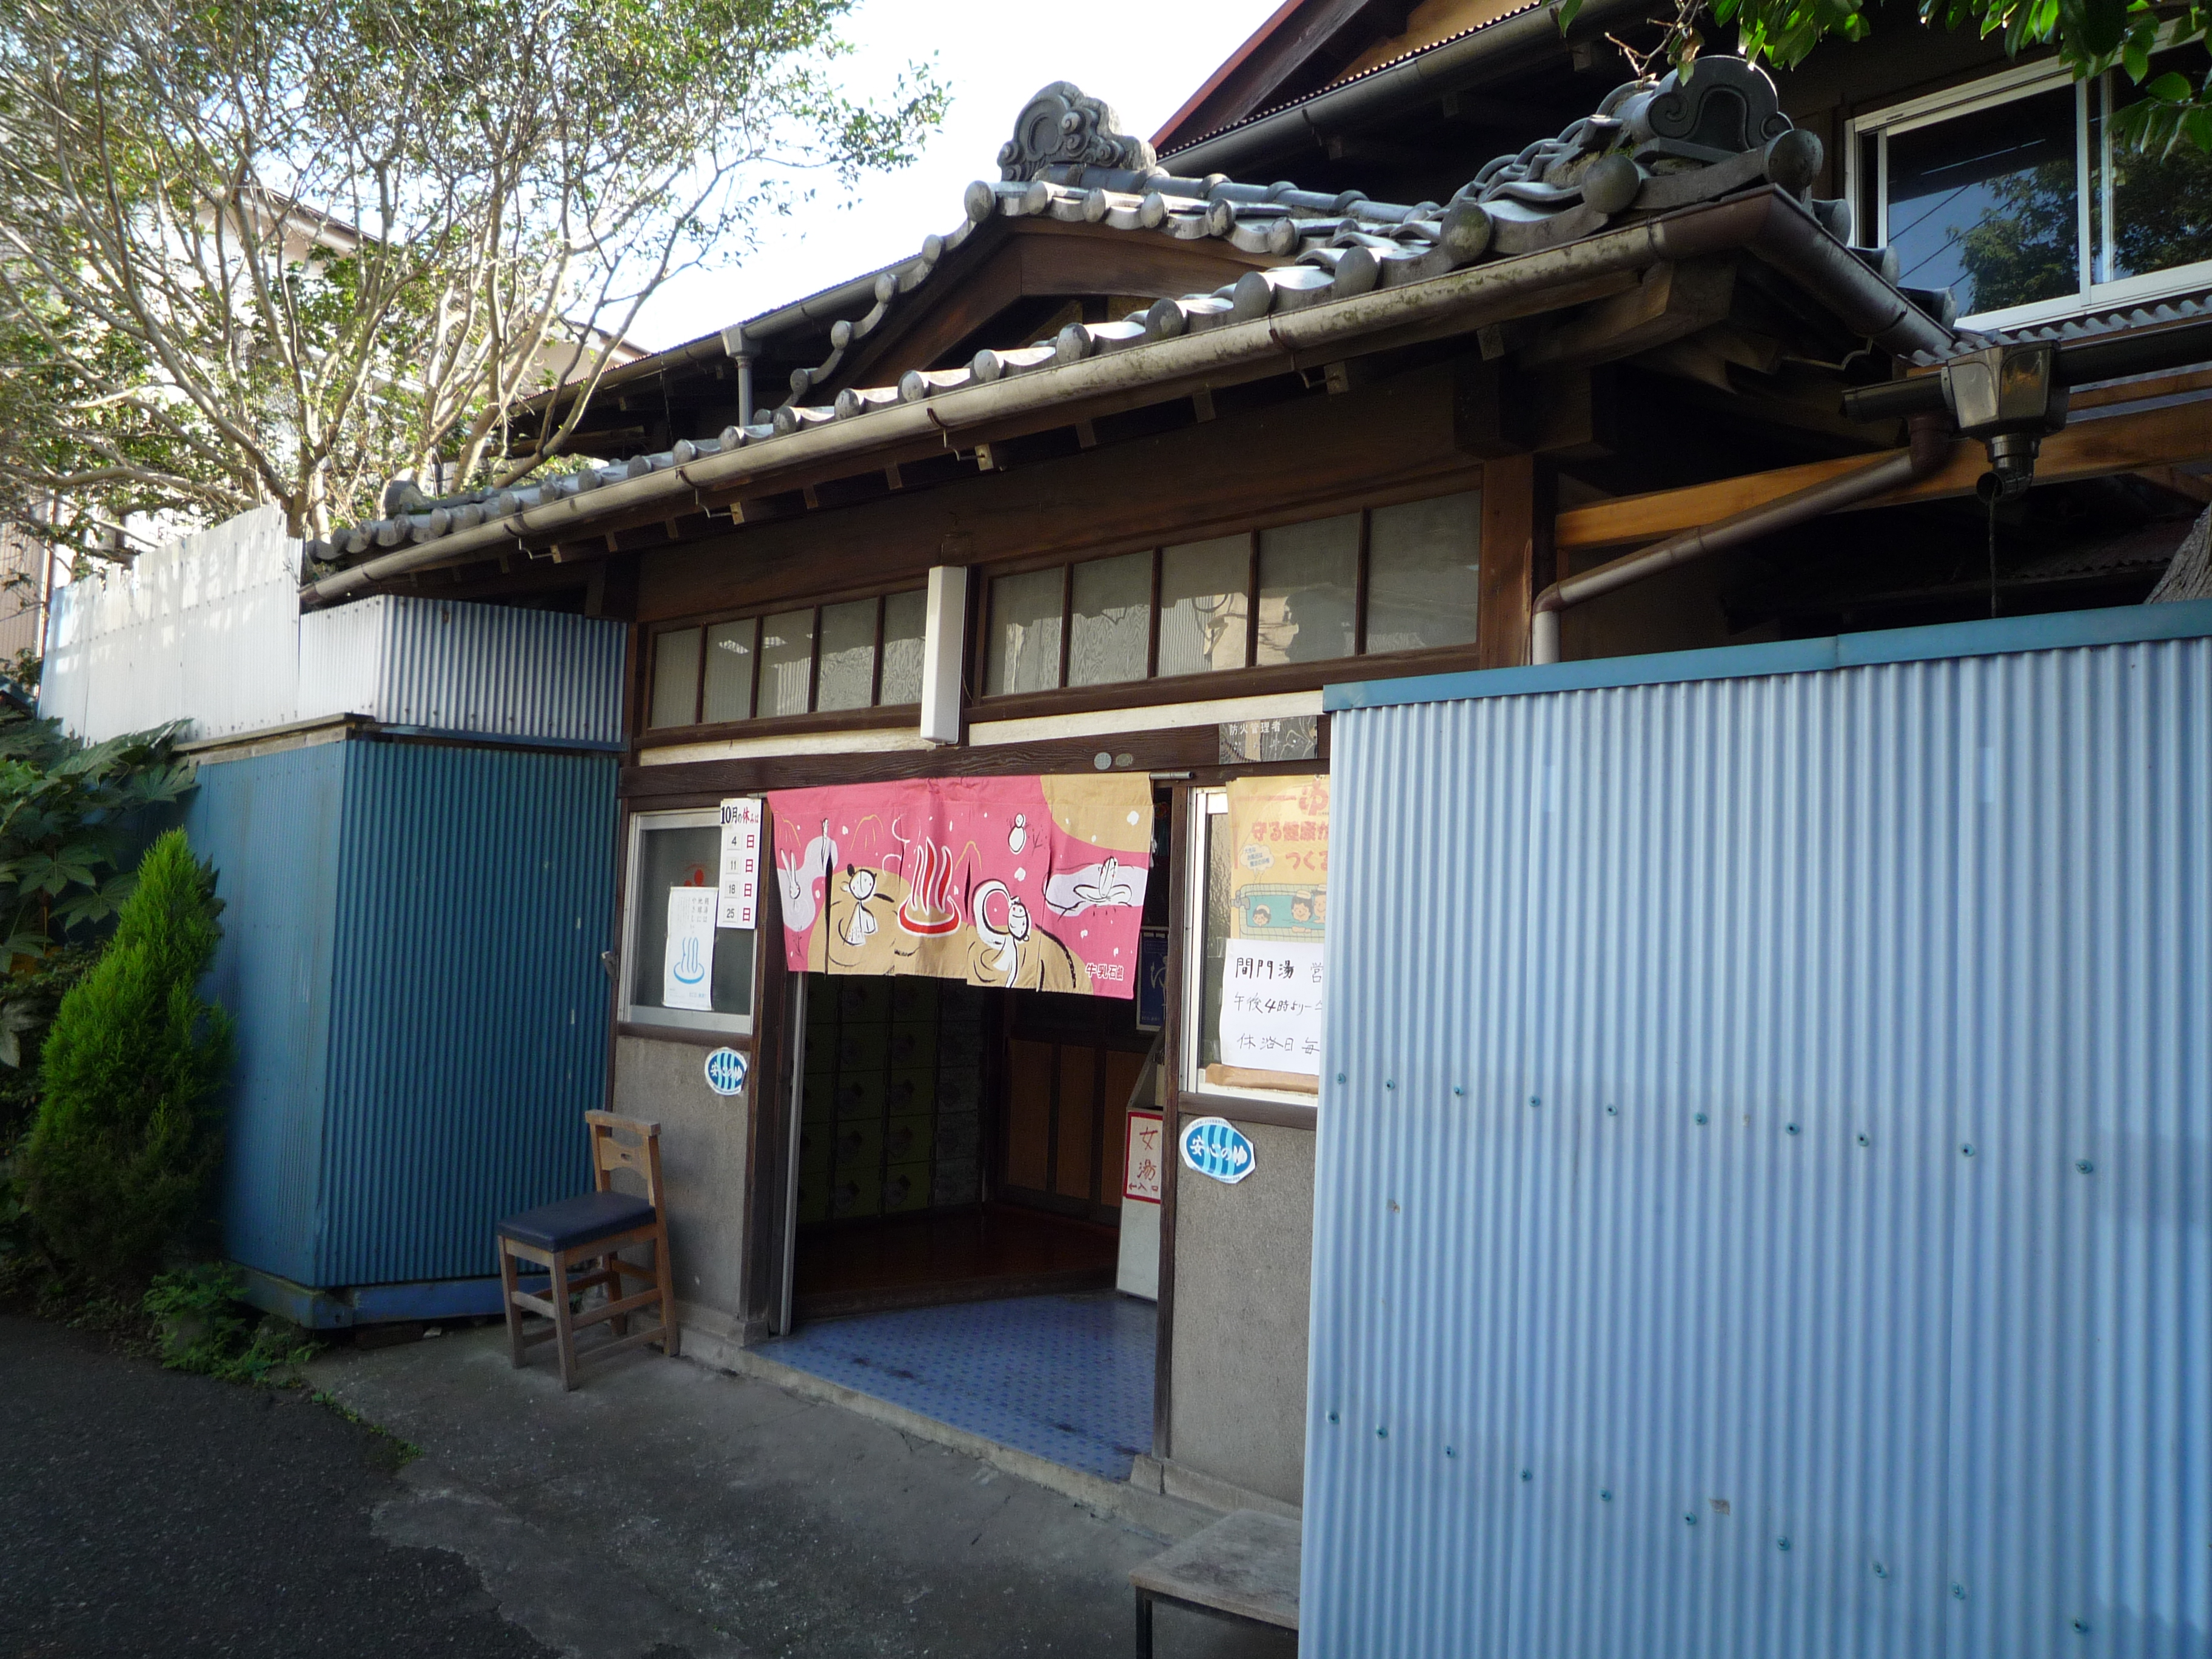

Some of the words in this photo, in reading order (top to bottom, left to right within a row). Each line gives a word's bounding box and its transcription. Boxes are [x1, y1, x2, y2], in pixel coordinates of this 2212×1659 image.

[1229, 720, 1281, 736] 防火管理者
[720, 806, 759, 824] 10月の休みは
[1235, 957, 1295, 980] 間門湯
